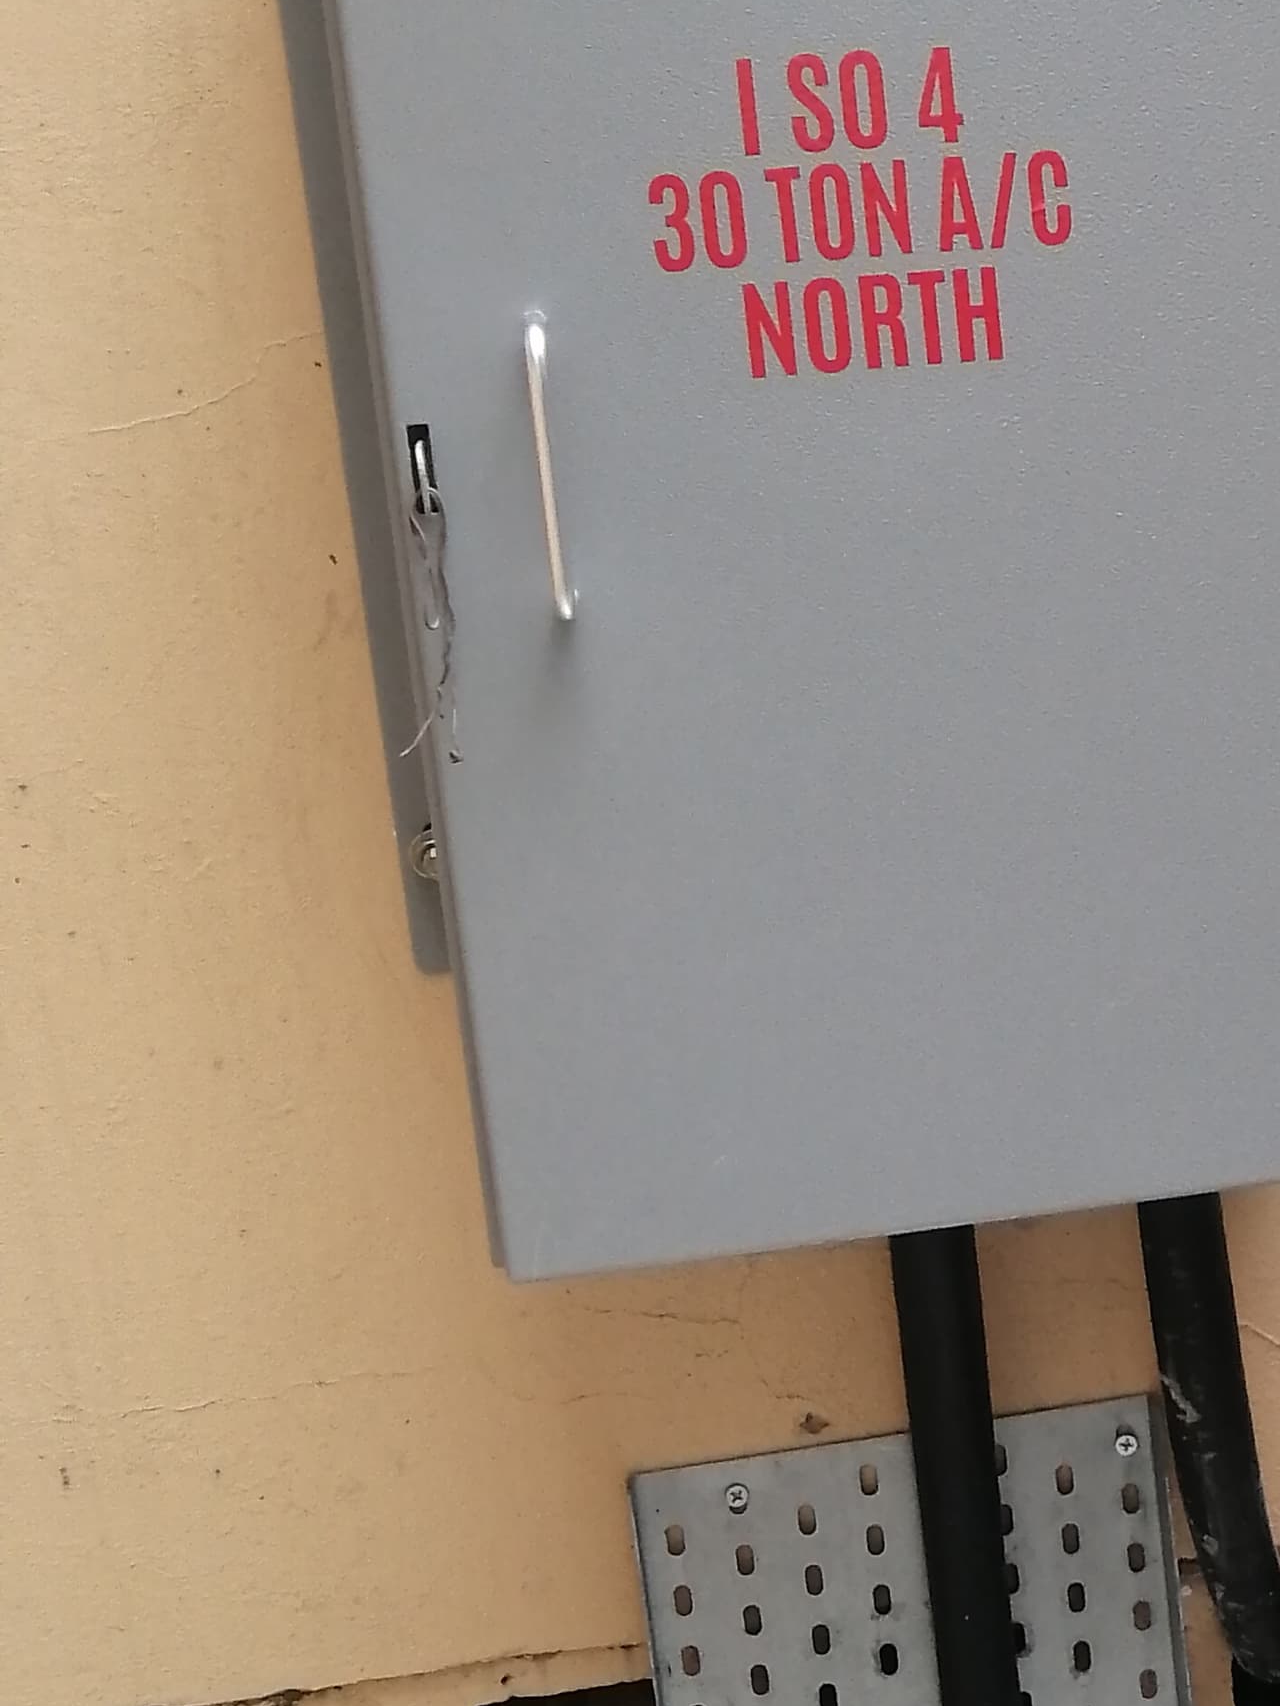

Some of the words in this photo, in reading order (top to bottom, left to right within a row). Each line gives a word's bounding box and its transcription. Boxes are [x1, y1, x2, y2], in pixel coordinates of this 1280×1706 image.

[917, 46, 963, 144] 4
[648, 170, 748, 272] 30
[764, 158, 913, 263] TON
[939, 149, 1072, 253] A/C
[742, 265, 1004, 379] NORTH
